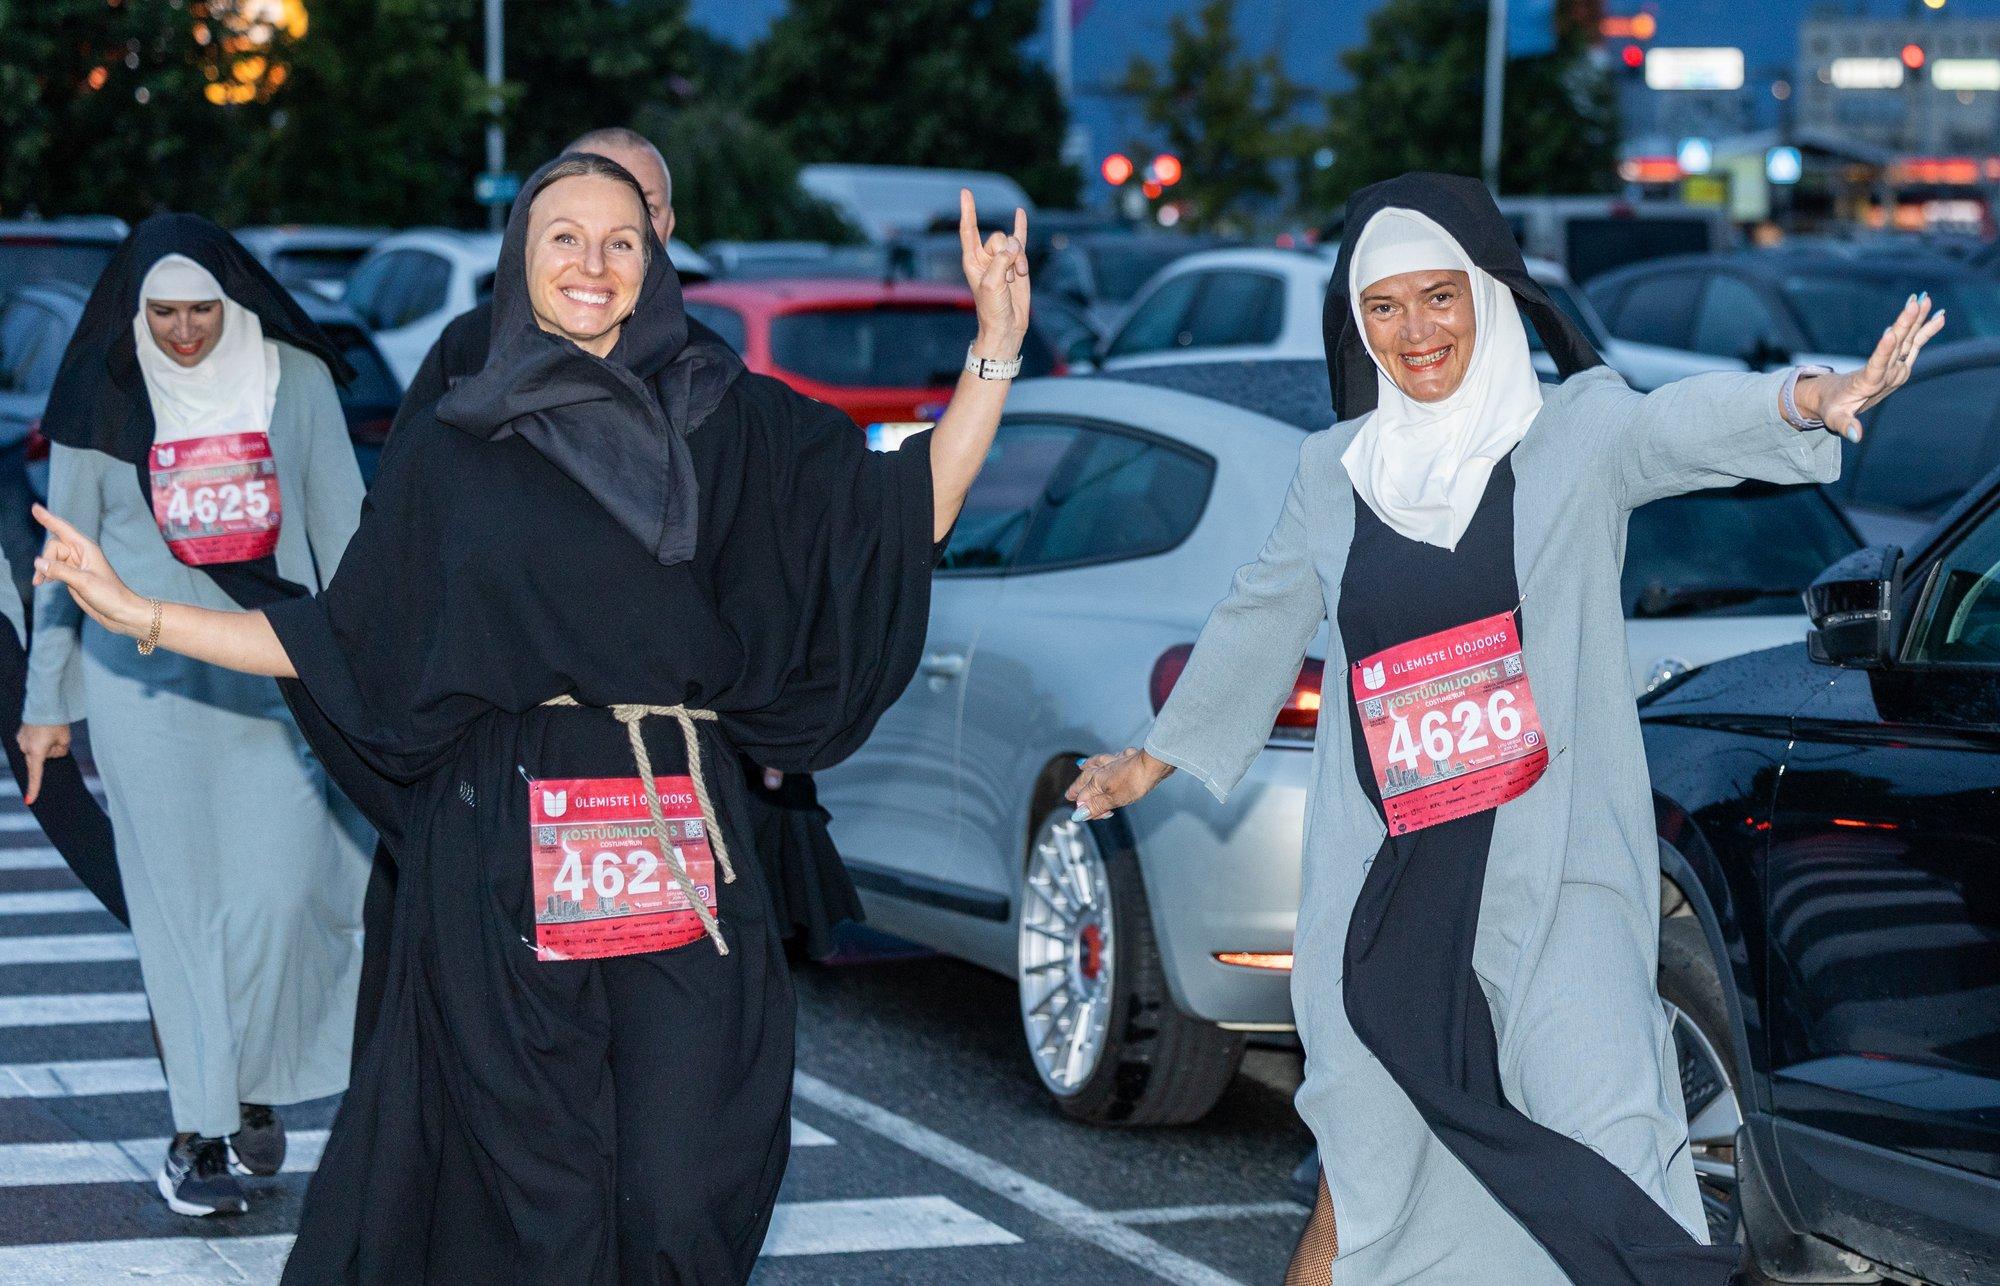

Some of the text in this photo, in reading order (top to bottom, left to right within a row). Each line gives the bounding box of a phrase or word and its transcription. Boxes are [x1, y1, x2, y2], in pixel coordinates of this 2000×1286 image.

[167, 480, 270, 526] 4625
[1392, 649, 1447, 676] ÜLEMISTE
[1455, 631, 1508, 657] ÖÖJOOKS
[1386, 666, 1499, 710] KOSTÜÜMIJOOKS
[1387, 689, 1522, 770] 4626
[575, 795, 630, 808] ÜLEMISTE
[561, 825, 678, 843] KOSTÜÜMIJOOS
